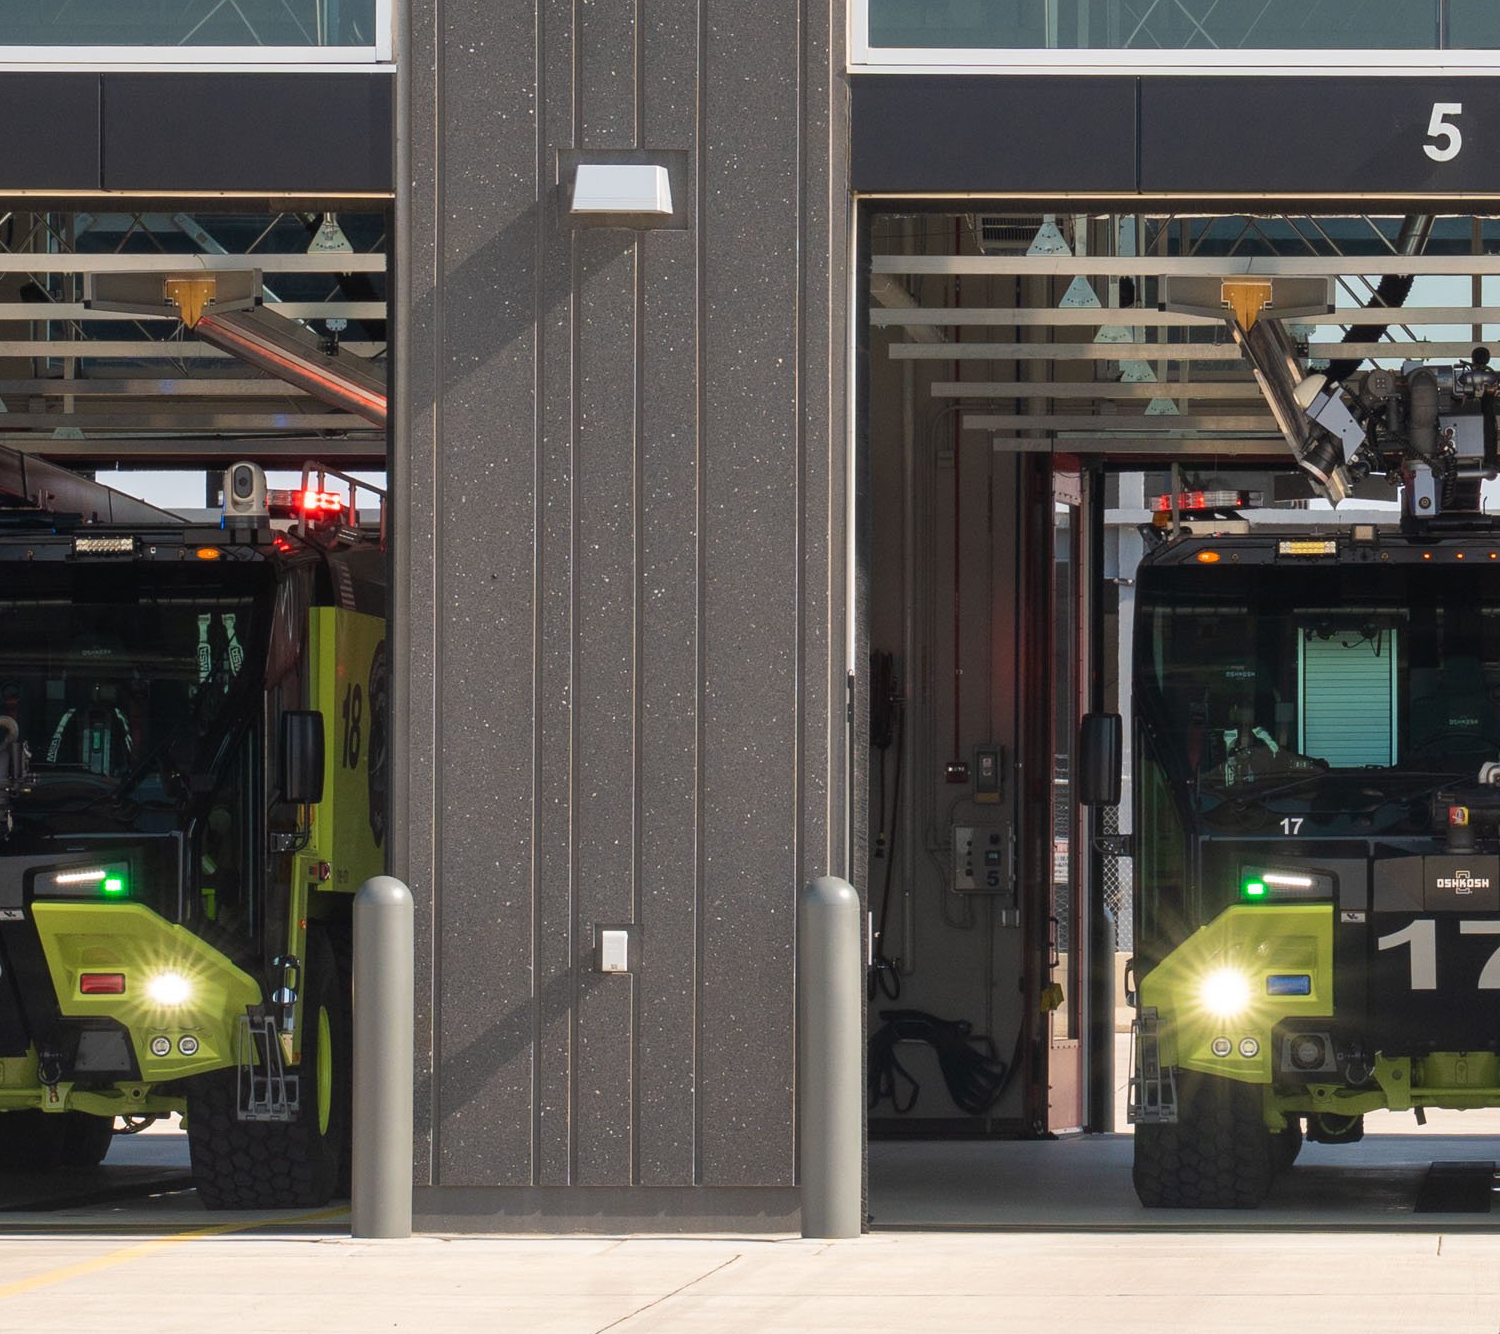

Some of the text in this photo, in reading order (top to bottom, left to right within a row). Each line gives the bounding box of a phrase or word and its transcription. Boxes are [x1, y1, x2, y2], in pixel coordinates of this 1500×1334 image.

[1422, 102, 1463, 162] 5
[199, 647, 208, 672] MSA
[341, 682, 362, 770] 18
[1279, 817, 1304, 835] 17
[986, 870, 1000, 887] 5
[1436, 878, 1490, 889] OSHKOSH
